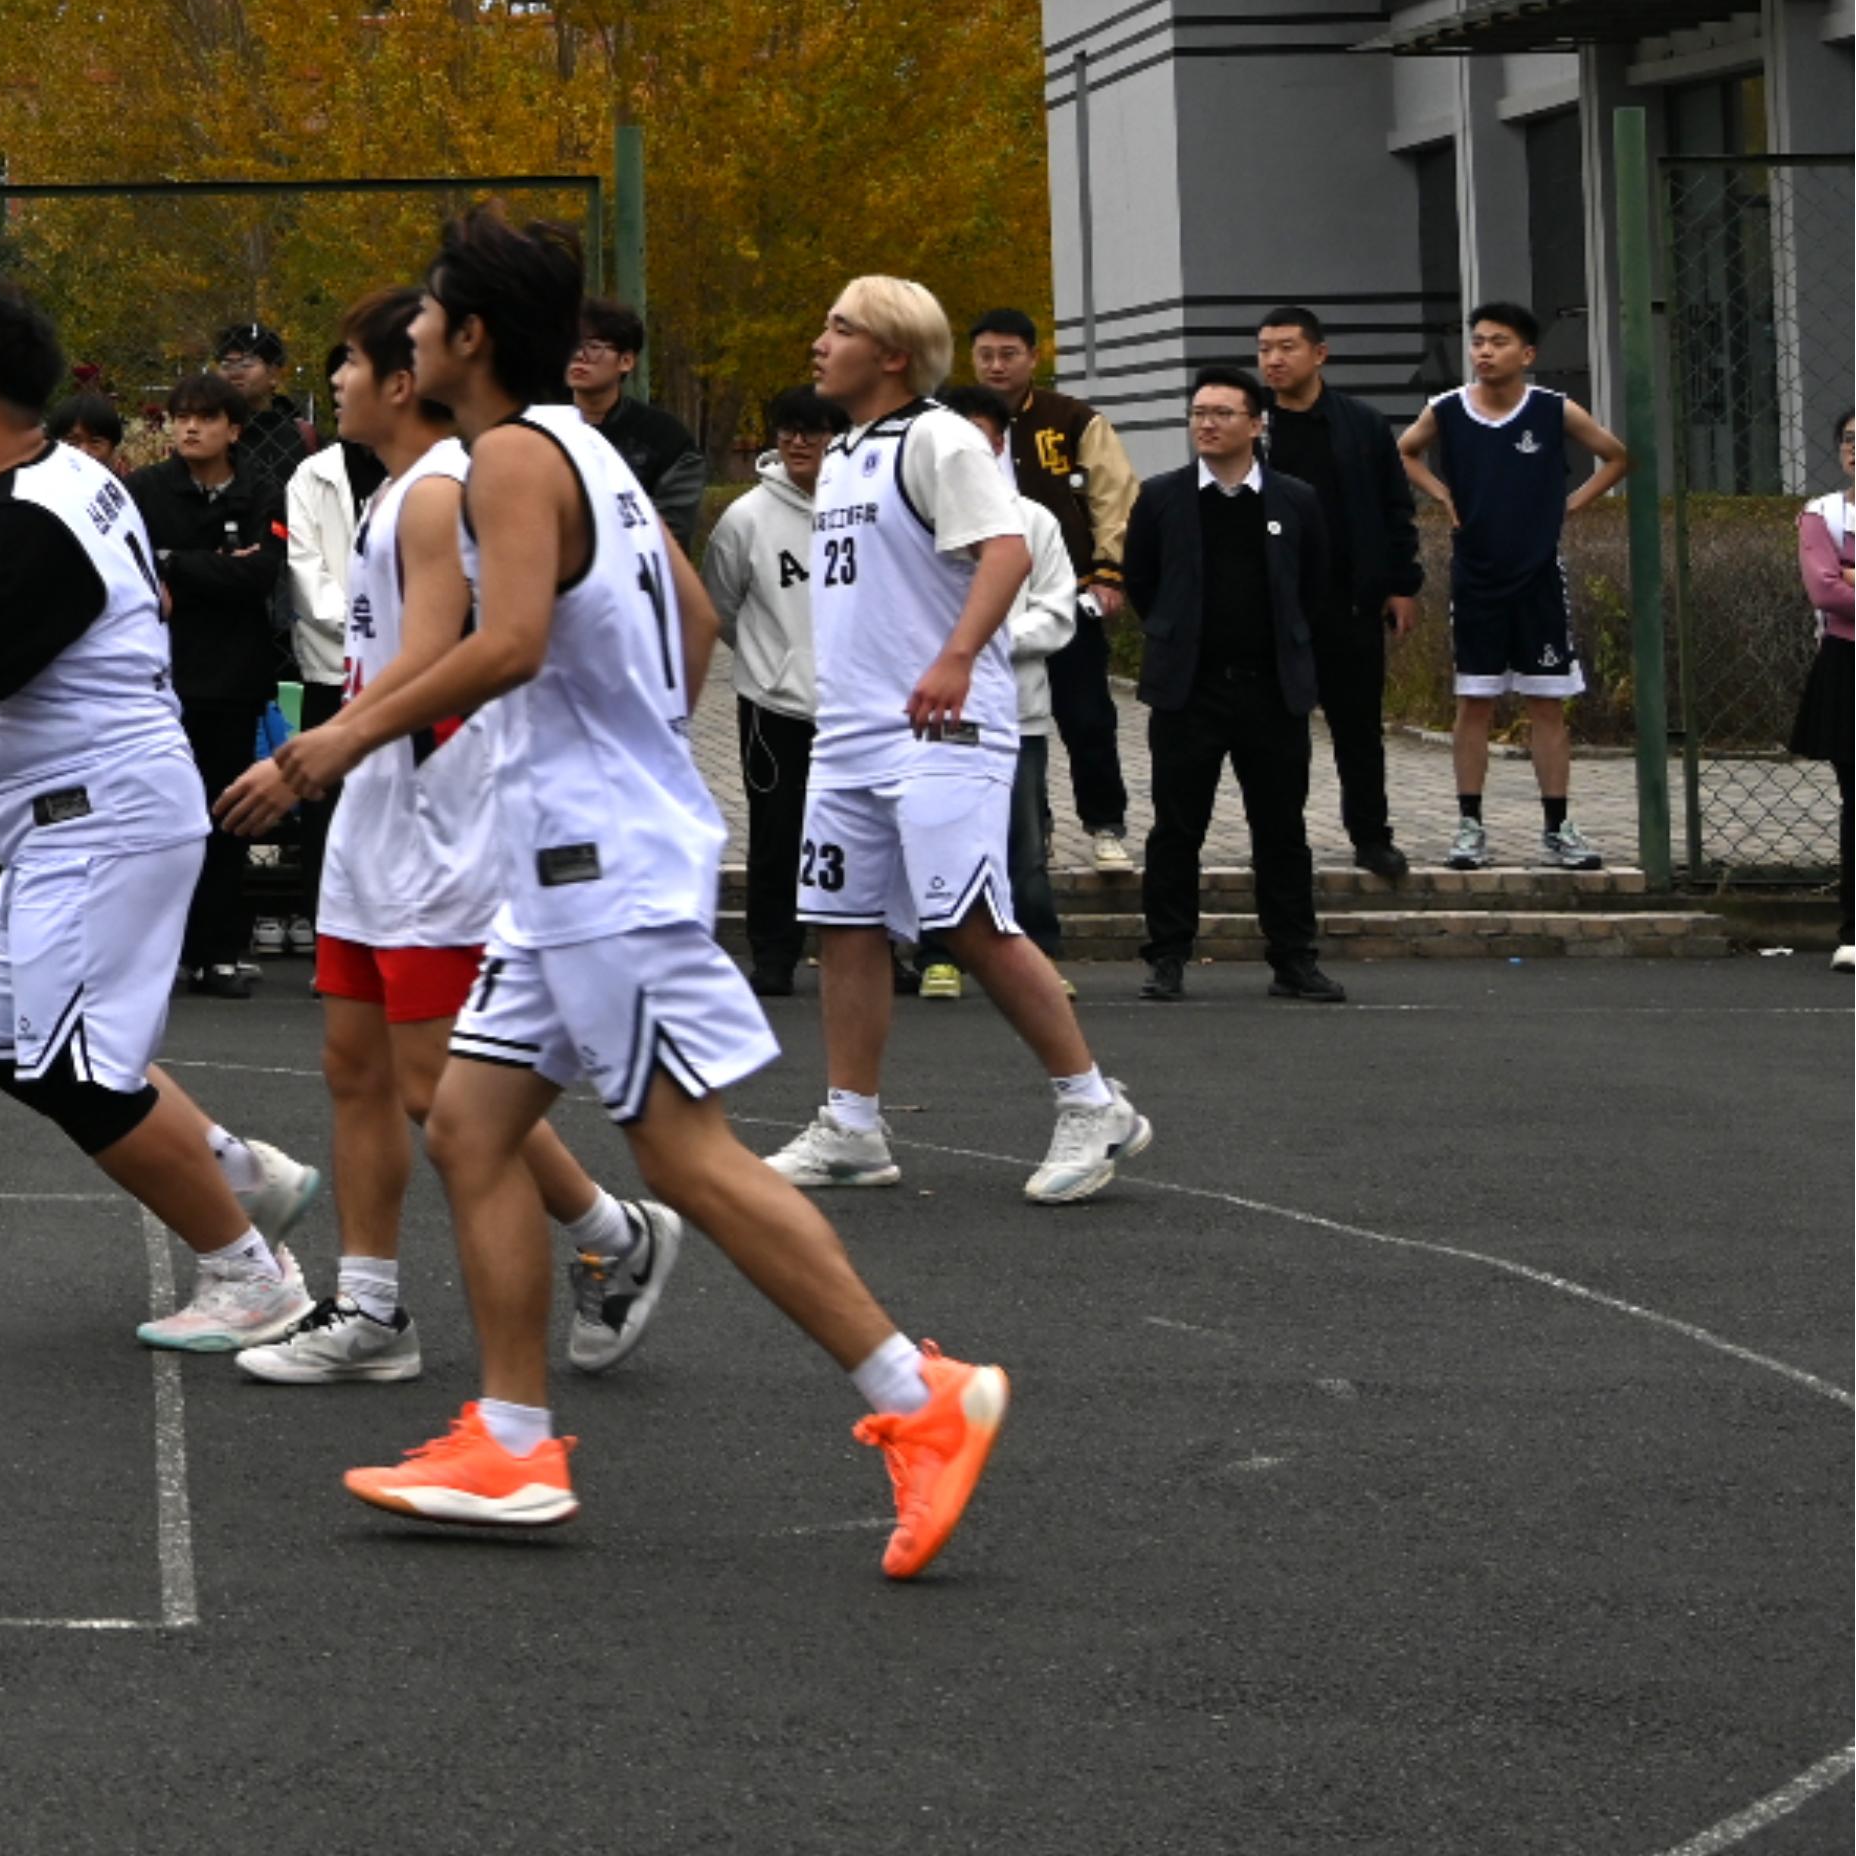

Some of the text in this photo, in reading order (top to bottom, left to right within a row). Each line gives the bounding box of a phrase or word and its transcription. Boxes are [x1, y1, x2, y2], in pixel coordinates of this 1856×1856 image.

[777, 548, 810, 588] A
[824, 535, 857, 588] 23
[799, 837, 845, 893] 23
